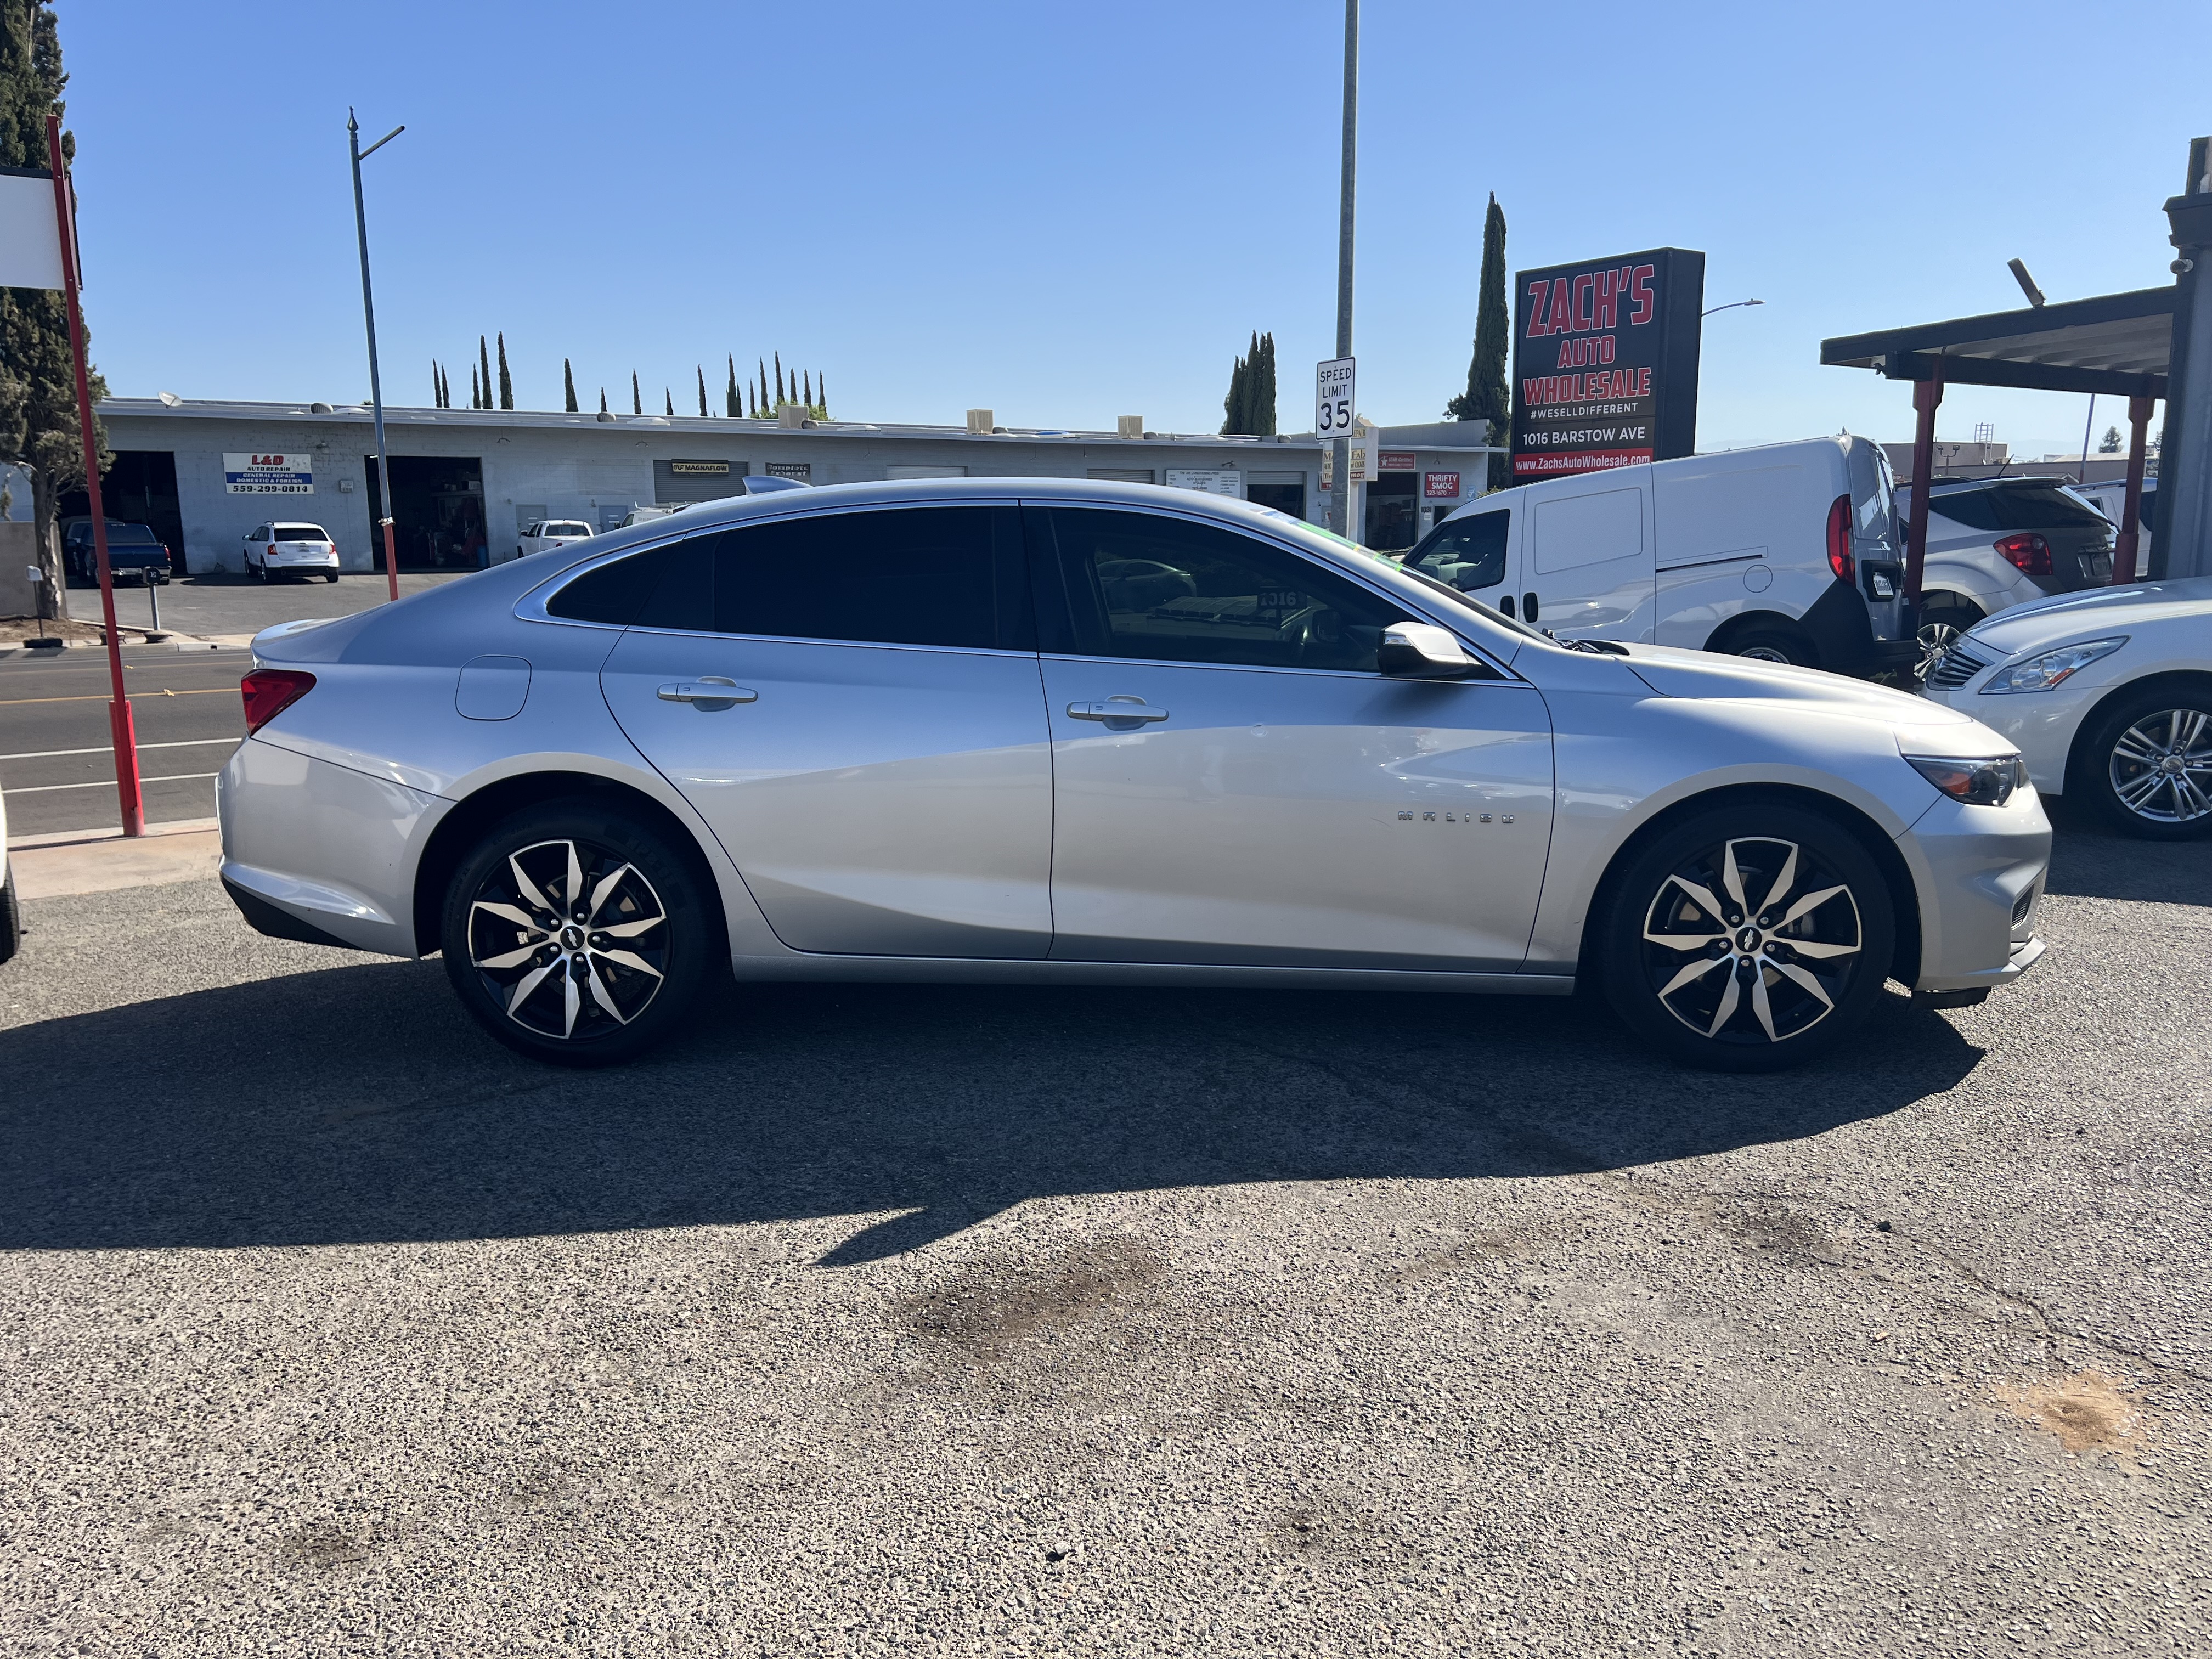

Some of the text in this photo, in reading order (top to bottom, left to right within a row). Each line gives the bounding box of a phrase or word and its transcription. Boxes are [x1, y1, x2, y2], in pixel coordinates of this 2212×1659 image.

[1526, 264, 1655, 338] ZACH'S
[1557, 335, 1616, 369] AUTO
[1319, 368, 1352, 383] SPEED
[1323, 384, 1347, 398] LIMIT
[1523, 367, 1651, 405] WHOLESALE
[1319, 400, 1350, 431] 35
[1531, 402, 1638, 419] #WESELLDIFFERENT
[1353, 428, 1366, 438] EPAIR
[1523, 426, 1645, 445] 1016 BARSTOW AVE
[252, 455, 284, 465] L&D
[1516, 454, 1650, 470] www.ZachsAutoWholesale.com
[1398, 811, 1514, 823] MALIBU
